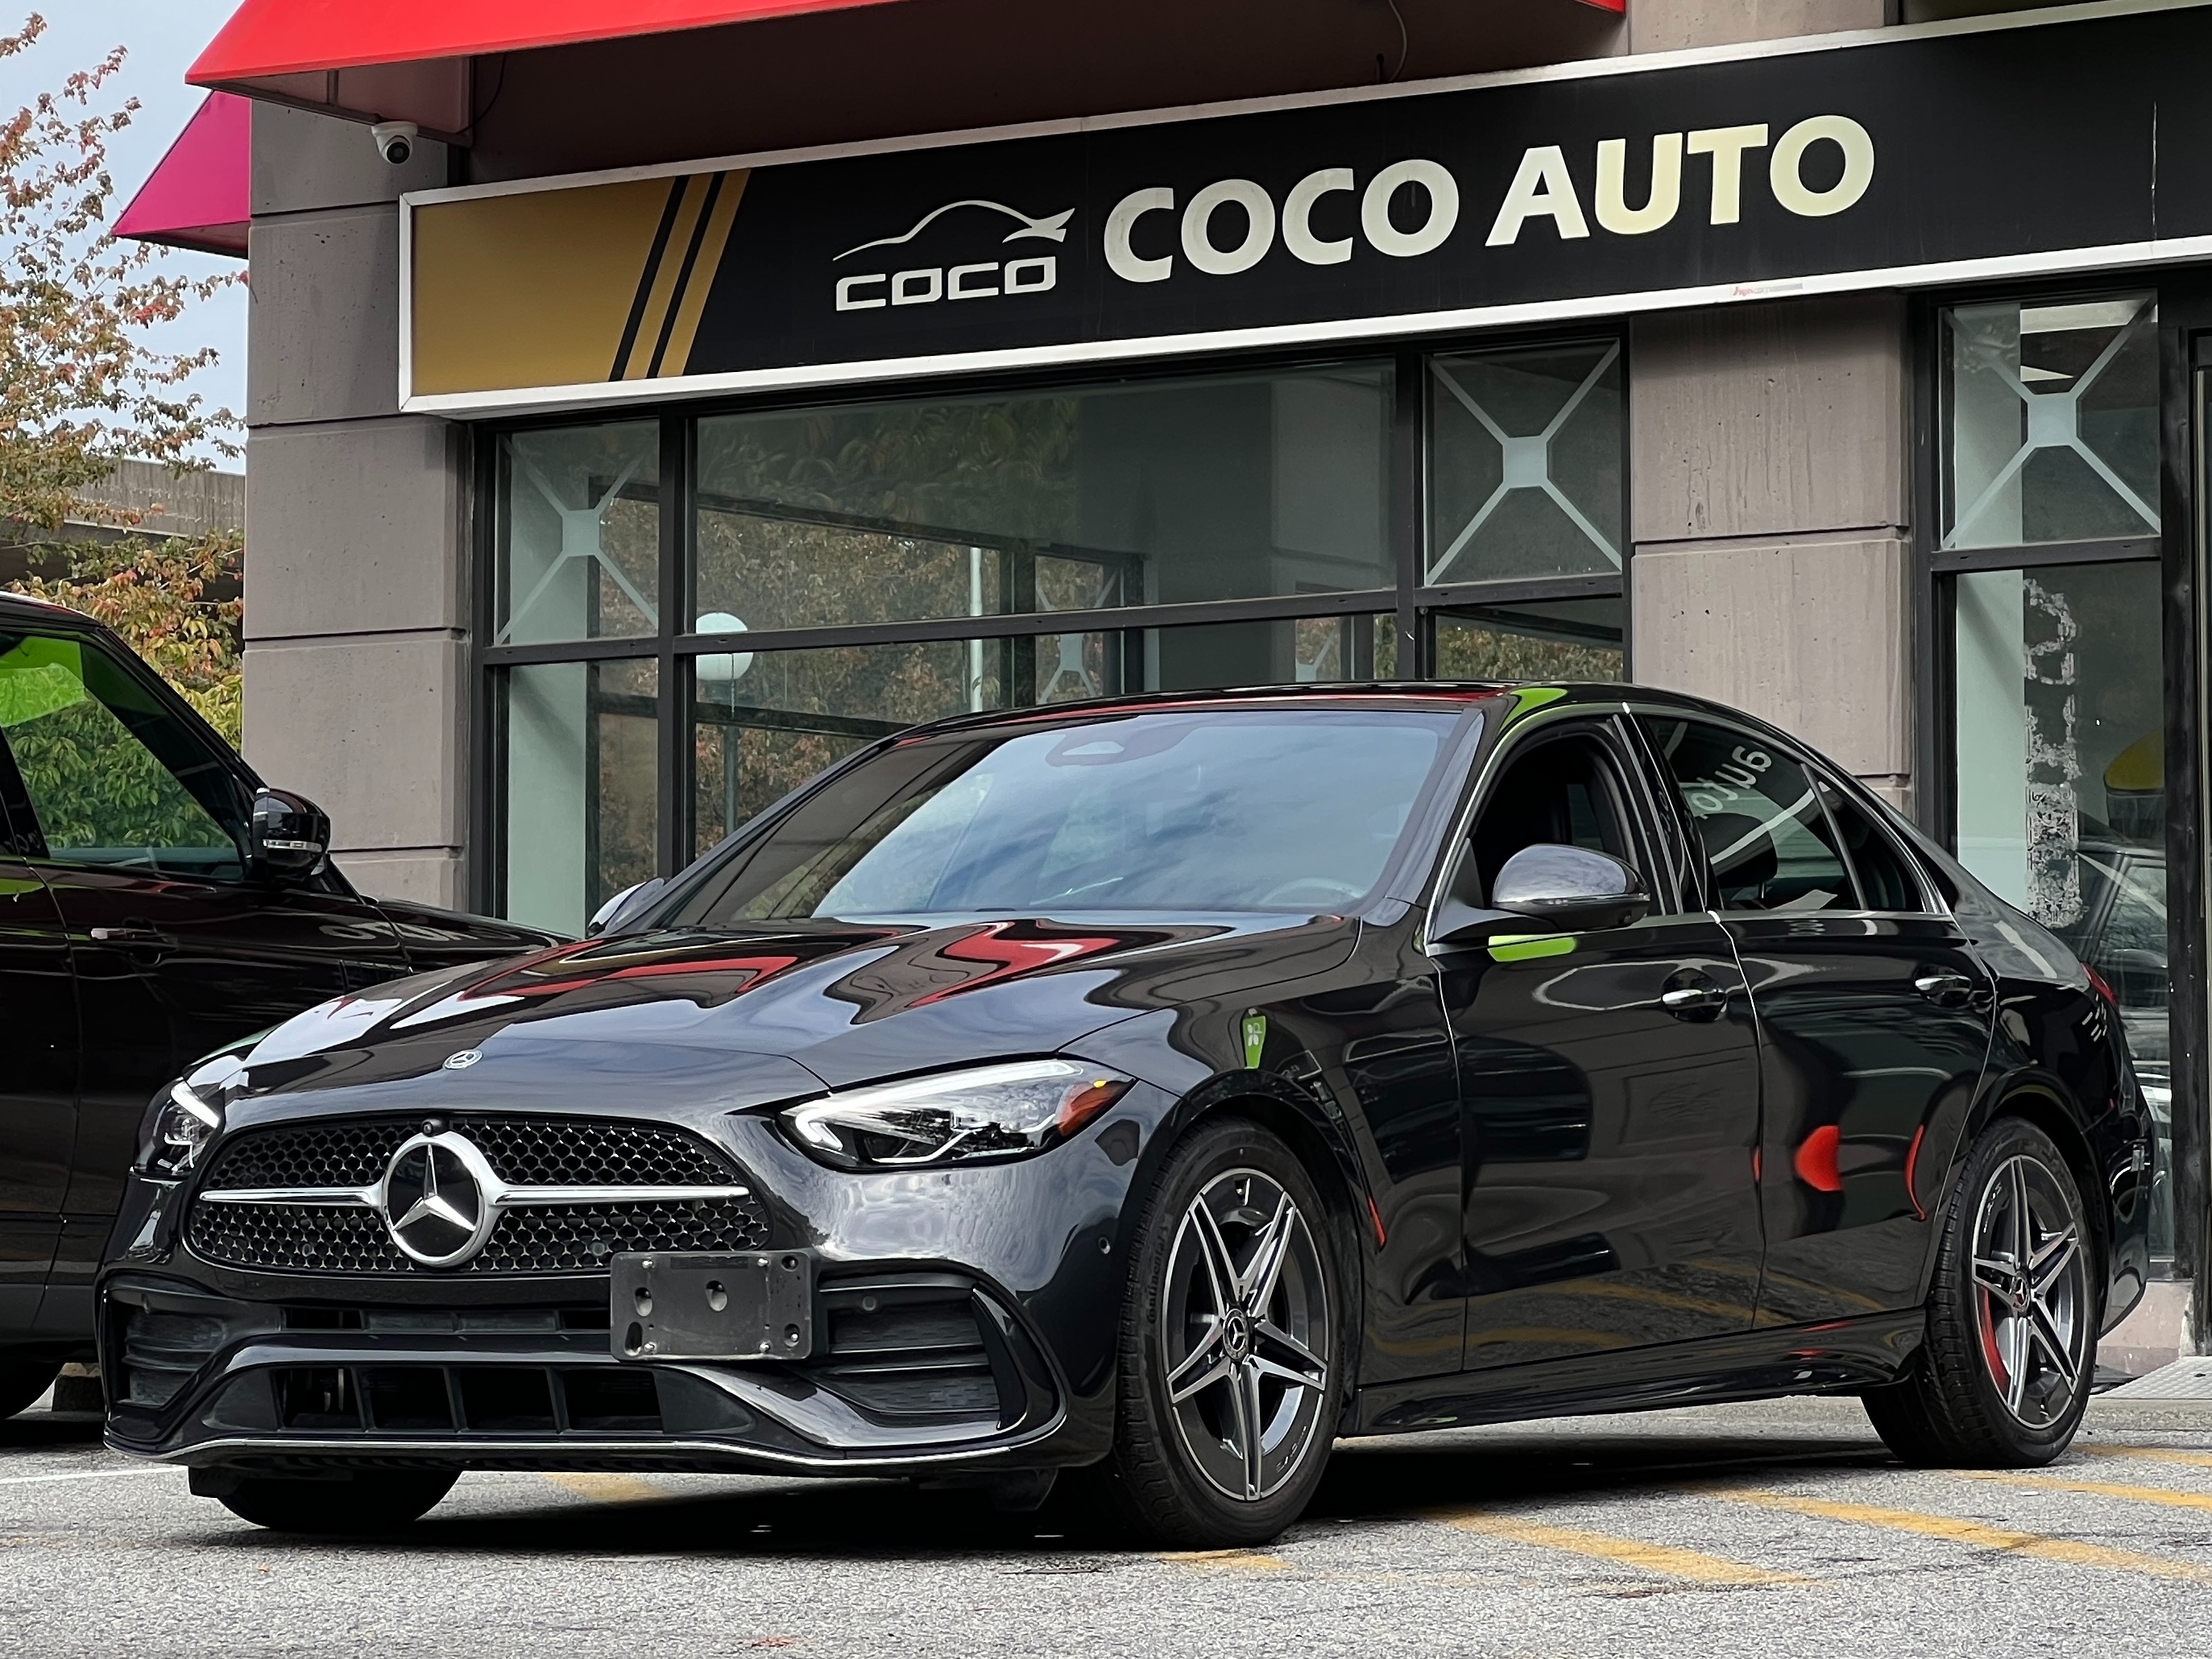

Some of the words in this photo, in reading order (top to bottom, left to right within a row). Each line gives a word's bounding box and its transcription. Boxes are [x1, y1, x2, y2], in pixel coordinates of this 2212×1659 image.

[1104, 159, 1459, 282] COCO
[1485, 115, 1874, 246] AUTO
[835, 257, 1056, 312] COCO
